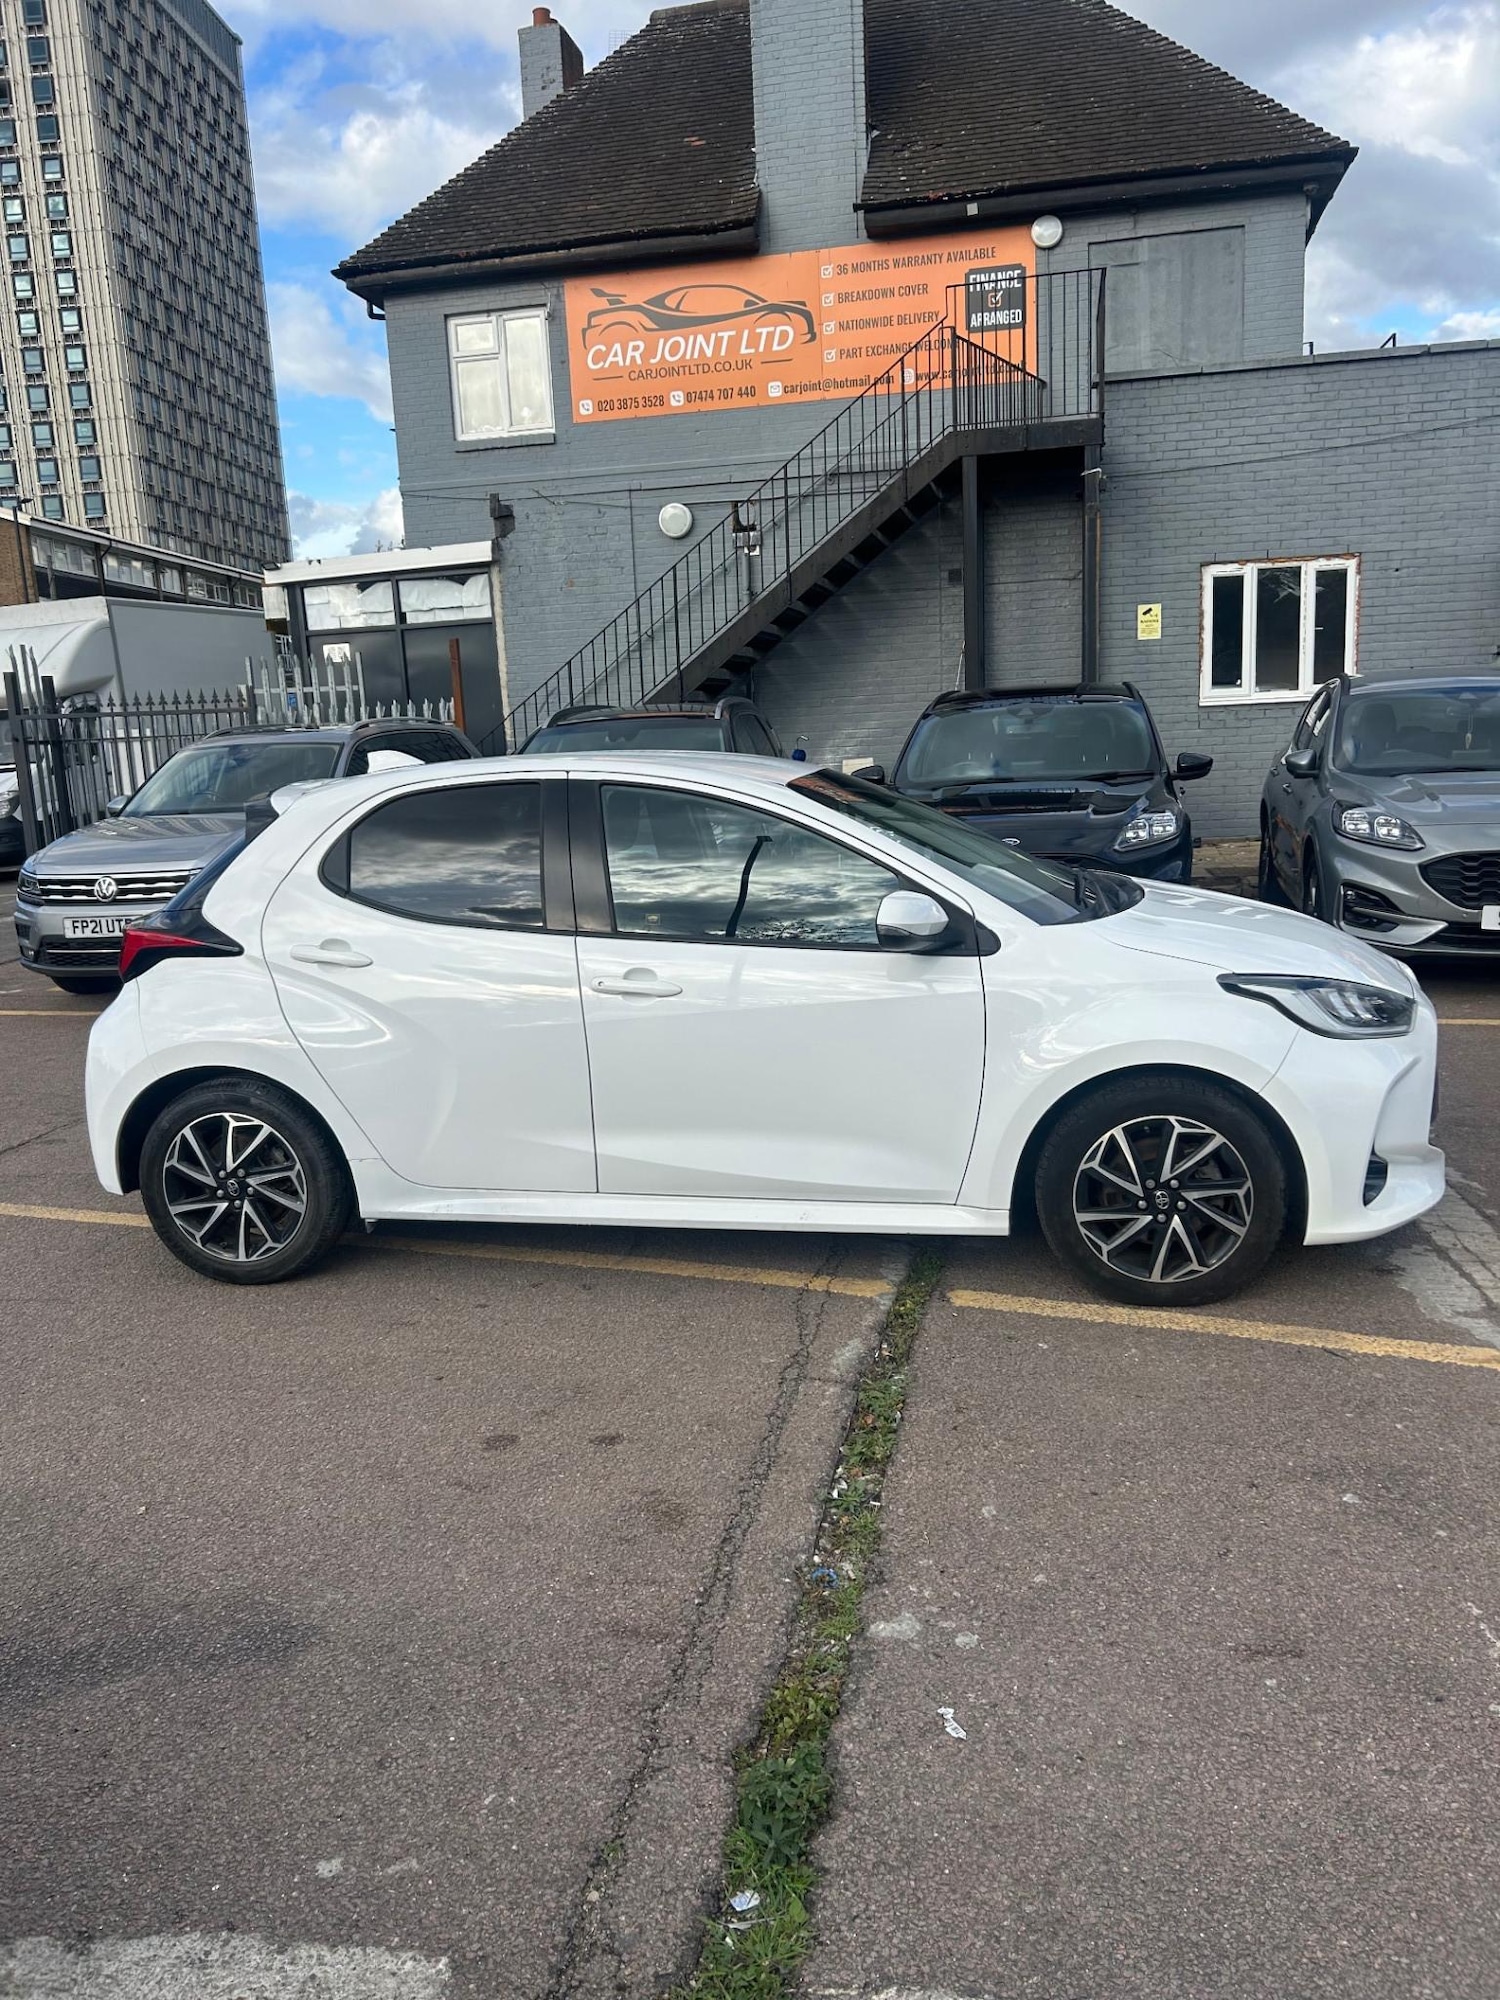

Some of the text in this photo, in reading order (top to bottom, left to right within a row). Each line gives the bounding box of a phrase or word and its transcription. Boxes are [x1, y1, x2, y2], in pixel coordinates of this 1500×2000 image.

[836, 246, 996, 276] 36 MONTHS WARRANTY AVAILABLE
[969, 269, 1022, 292] FINANCE
[837, 283, 929, 304] BREAKDOWN COVER
[838, 310, 940, 332] NATIONWIDE DELIVERY
[970, 308, 1023, 328] ARRANGED
[586, 325, 794, 370] CAR JOINT LTD
[839, 346, 863, 360] PART
[865, 341, 913, 358] EXCHANGE
[628, 358, 753, 381] CARJOINTLTD.CO.UK
[597, 395, 665, 412] 020 3875 3528
[686, 385, 756, 403] 07474 707 440
